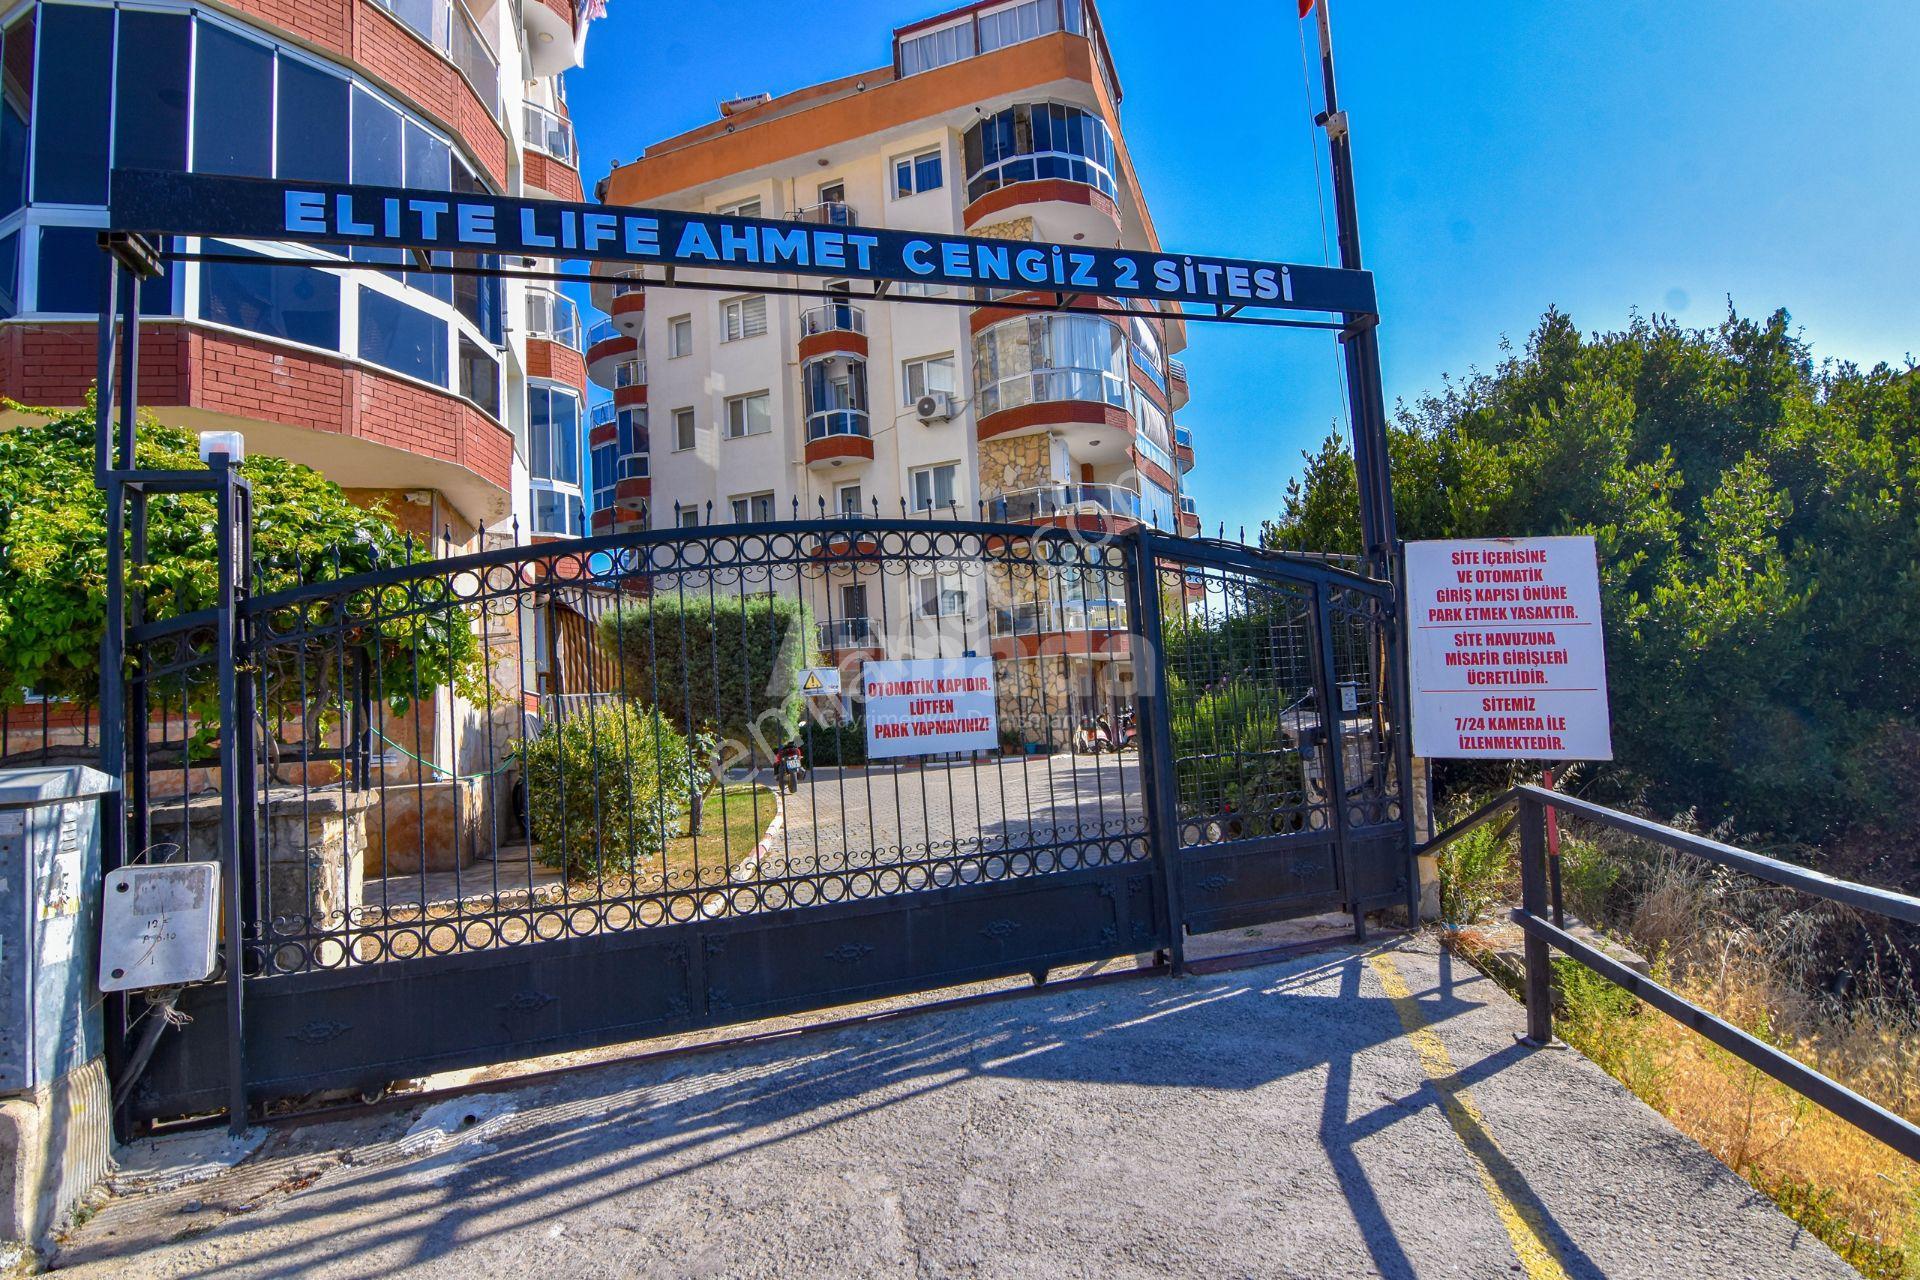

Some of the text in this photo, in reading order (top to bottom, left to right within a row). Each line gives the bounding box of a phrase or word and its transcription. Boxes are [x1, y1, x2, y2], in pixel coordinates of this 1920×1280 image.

[284, 190, 1294, 302] ELITE LIFE AHMET CENGİZ 2 SİTESİ
[1451, 548, 1547, 567] SİTE İÇERİSİNE
[1456, 567, 1543, 583] VE OTOMATİK
[1436, 585, 1567, 605] GİRİŞ KAPISI ÖNÜNE
[1428, 605, 1579, 622] PARK ETMEK YASAKTIR.
[1454, 630, 1556, 647] SİTE HAVUZUNA
[1445, 649, 1569, 667] MİSAFİR GİRİŞLERİ
[1467, 669, 1548, 685] ÜCRETLİDİR.
[868, 677, 992, 697] OTOMATİK KAPIDIR.
[909, 698, 954, 716] LÜTFEN
[1482, 696, 1536, 712] SİTEMİZ
[874, 717, 990, 739] PARK YAPMAYINIZ!
[1454, 714, 1566, 731] 7/24 KAMERA İLE
[1459, 735, 1565, 750] İZLENMEKTEDİR.
